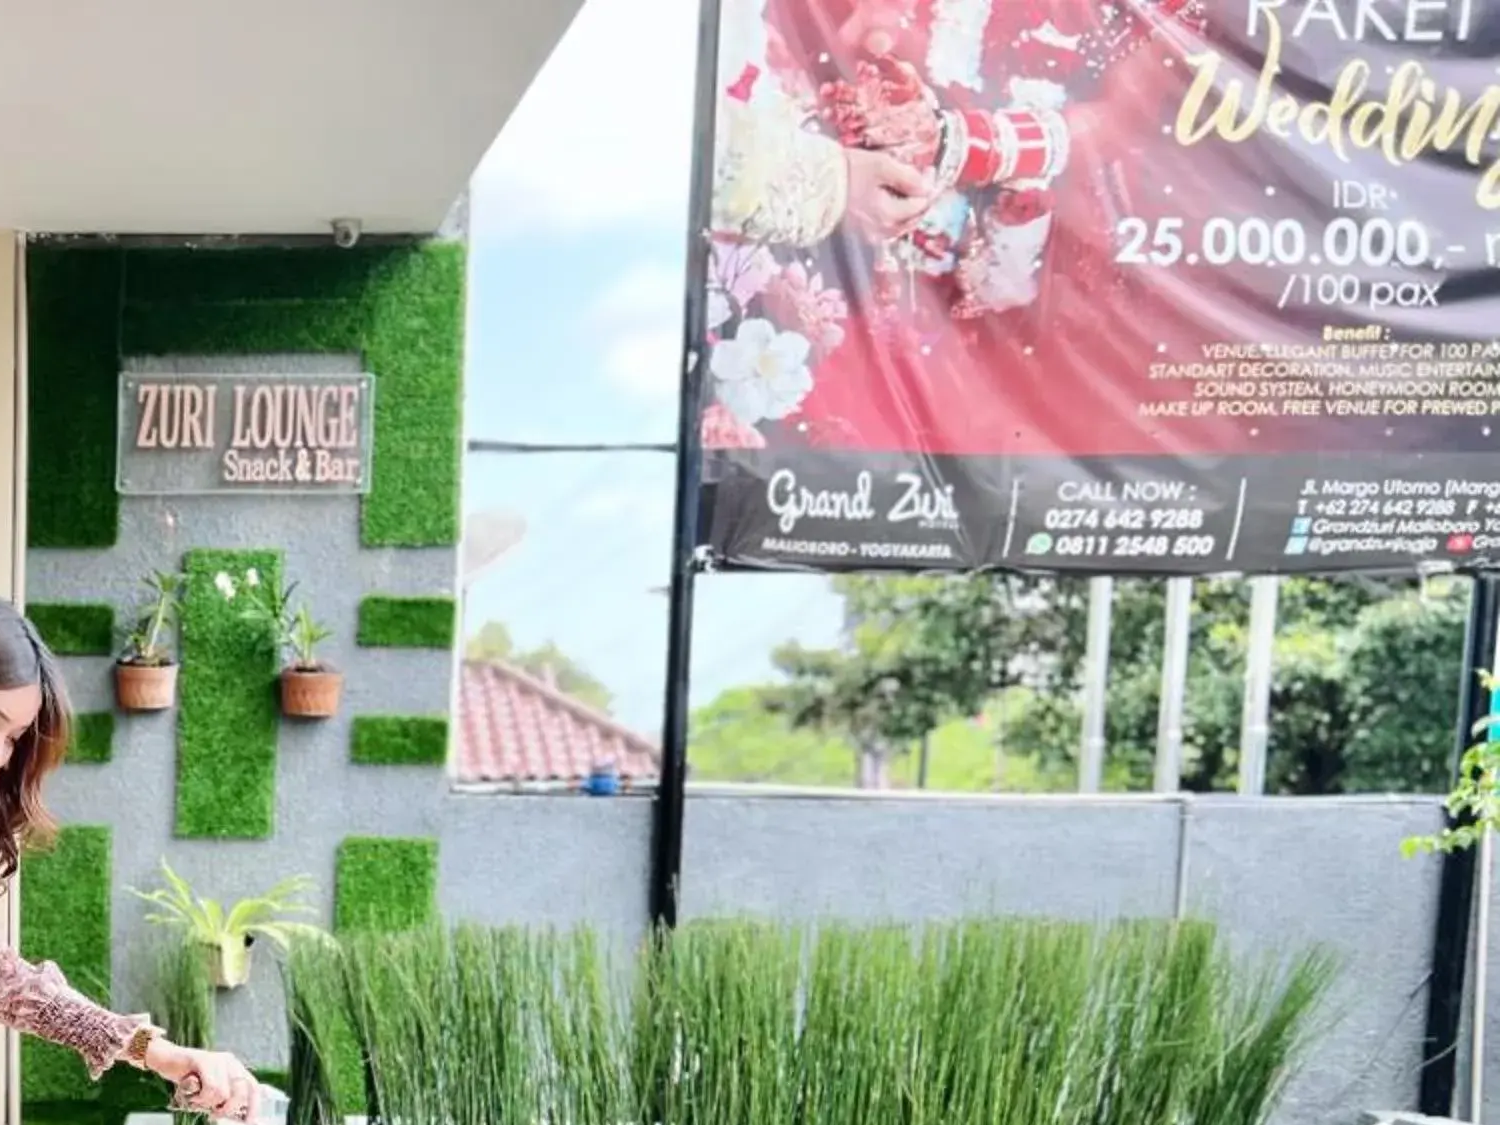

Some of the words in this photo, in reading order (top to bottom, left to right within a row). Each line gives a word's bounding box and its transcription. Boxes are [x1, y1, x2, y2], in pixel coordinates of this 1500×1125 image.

[1332, 180, 1390, 209] IDR
[1277, 273, 1361, 308] /100
[1368, 280, 1440, 308] pax
[1322, 325, 1382, 341] Benefit
[1399, 342, 1435, 359] FOR
[1440, 342, 1468, 359] 100
[1358, 362, 1413, 377] MUSIC
[1193, 381, 1256, 397] SOUND
[1328, 381, 1445, 397] HONEYMOON
[136, 384, 218, 448] ZURI
[230, 384, 360, 448] LOUNGE
[1138, 400, 1189, 416] MAKE
[1191, 400, 1215, 416] UP
[1281, 400, 1321, 416] FREE
[1325, 400, 1382, 416] VENUE
[1383, 400, 1418, 416] FOR
[1421, 400, 1488, 416] PREWED
[1056, 481, 1118, 501] CALL
[1122, 481, 1185, 501] NOW
[1321, 479, 1380, 497] Margo
[1383, 479, 1441, 496] Utomo
[767, 468, 875, 533] Grand
[887, 472, 959, 522] Zuri
[1348, 499, 1380, 515] 274
[1044, 508, 1099, 529] 0274
[1103, 508, 1146, 529] 642
[1149, 508, 1204, 529] 9288
[761, 536, 851, 557] MALIOBORO
[859, 541, 953, 560] YOGYAKARTA
[1054, 535, 1109, 555] 0811
[1112, 535, 1169, 555] 2548
[1171, 535, 1215, 555] 500
